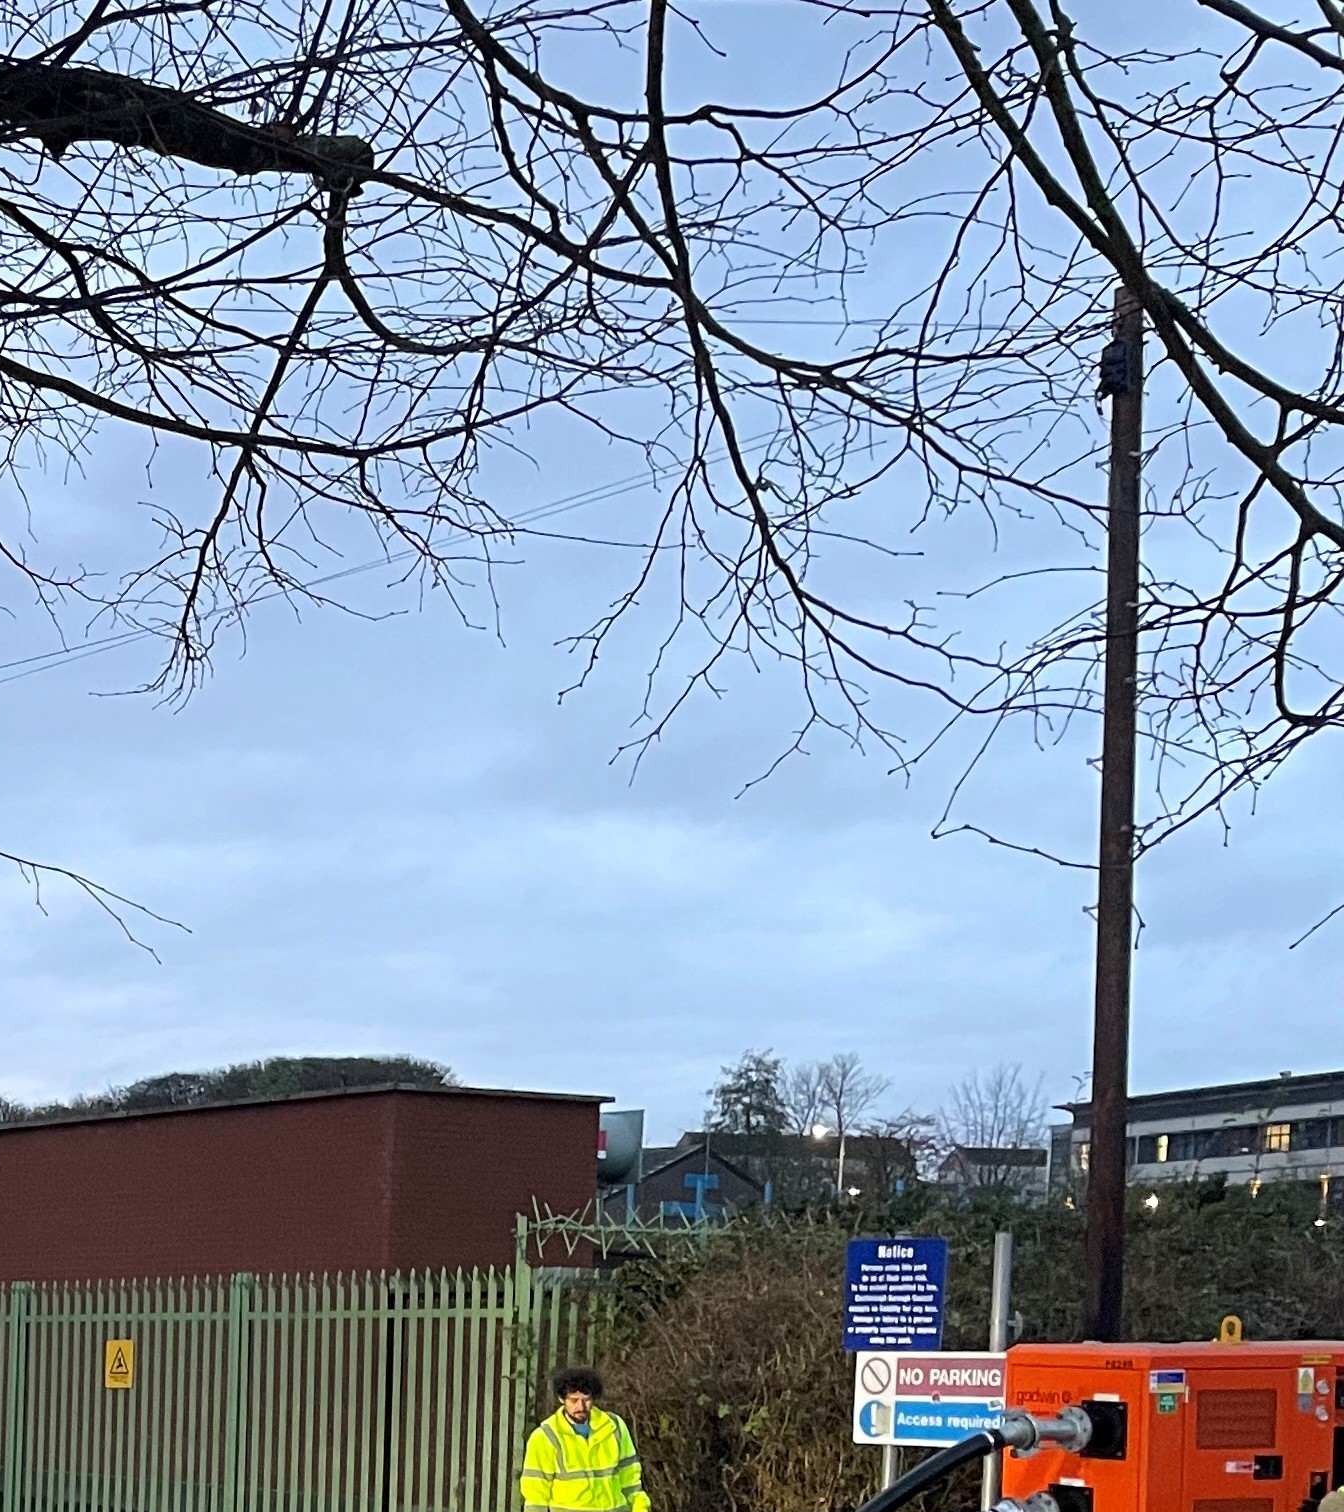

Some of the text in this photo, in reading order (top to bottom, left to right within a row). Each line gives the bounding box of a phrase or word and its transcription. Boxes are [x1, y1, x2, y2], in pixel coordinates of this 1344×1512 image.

[878, 1245, 914, 1258] Notice
[899, 1369, 1002, 1387] NO PARKING
[897, 1412, 1001, 1430] Access required
